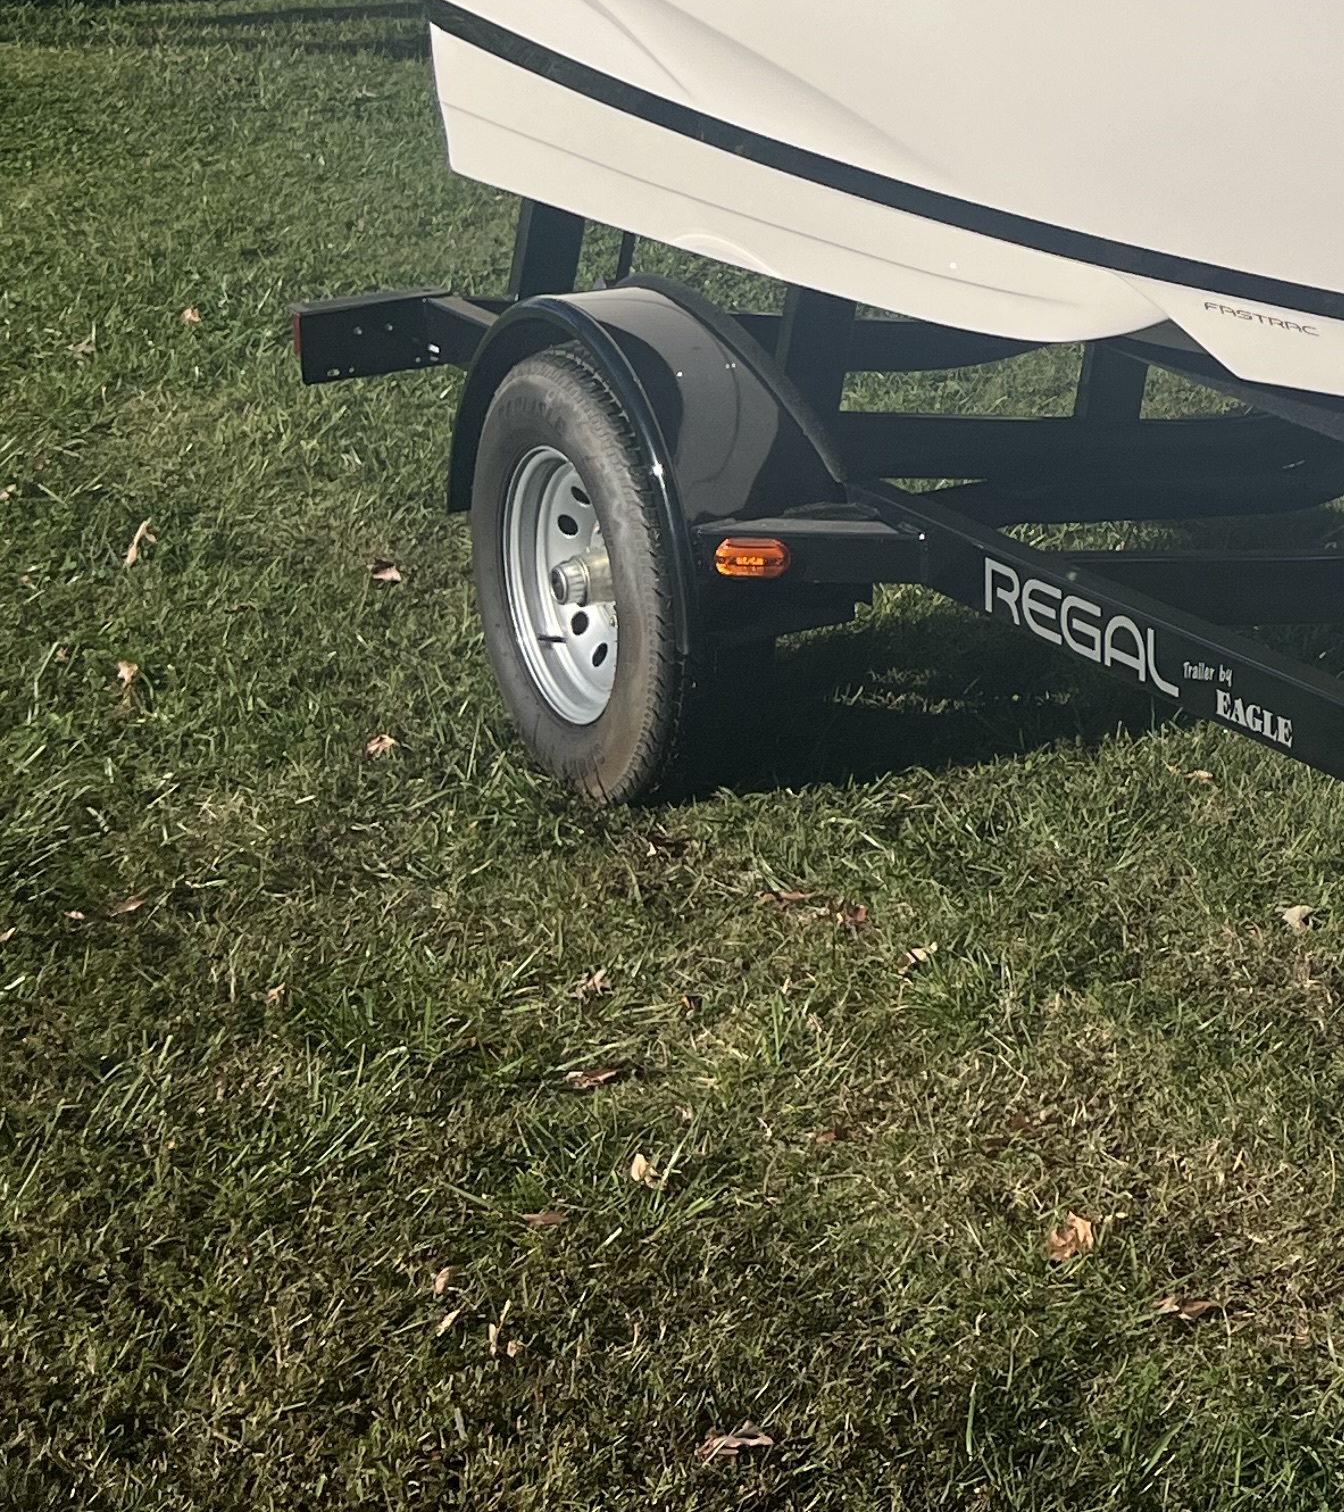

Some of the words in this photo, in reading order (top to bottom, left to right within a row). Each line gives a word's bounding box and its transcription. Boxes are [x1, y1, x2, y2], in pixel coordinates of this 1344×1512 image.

[1204, 301, 1320, 336] FASTRAC
[984, 556, 1180, 698] REGAL
[1219, 664, 1233, 686] by
[1216, 689, 1293, 748] EAGLE
